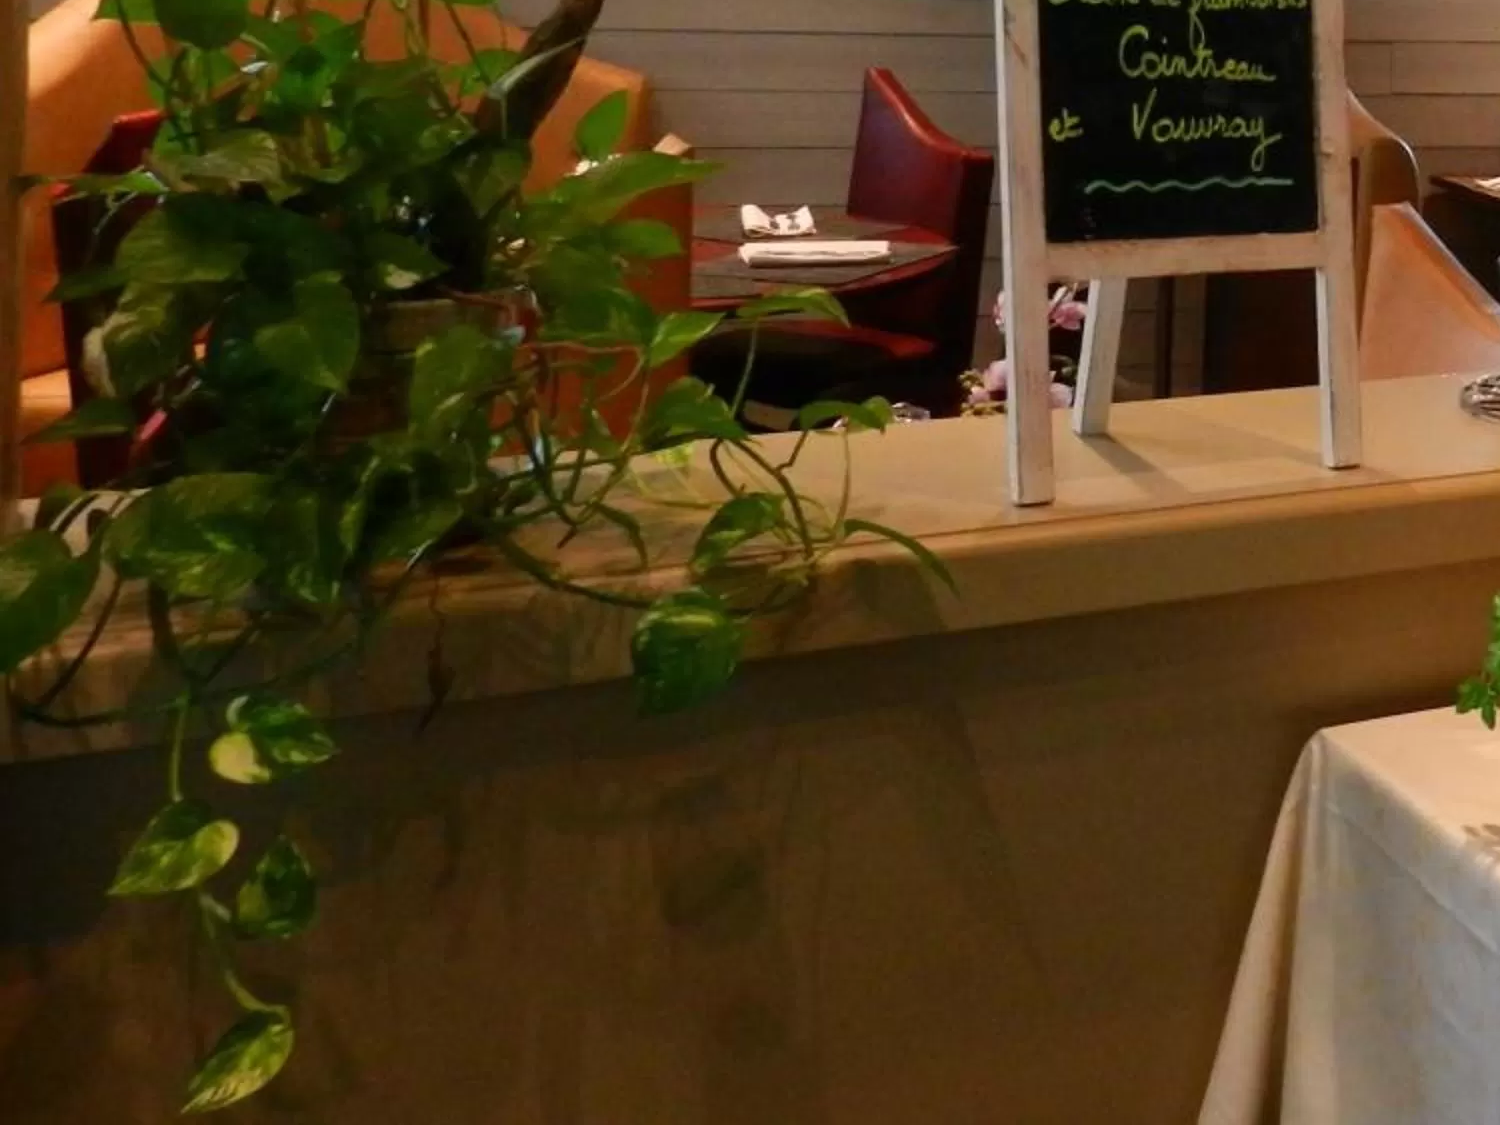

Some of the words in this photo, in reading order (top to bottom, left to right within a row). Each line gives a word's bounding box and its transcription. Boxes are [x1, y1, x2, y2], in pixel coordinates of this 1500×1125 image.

[1119, 25, 1277, 81] Cointreau
[1048, 108, 1085, 142] et
[1132, 88, 1283, 172] Vouvray
